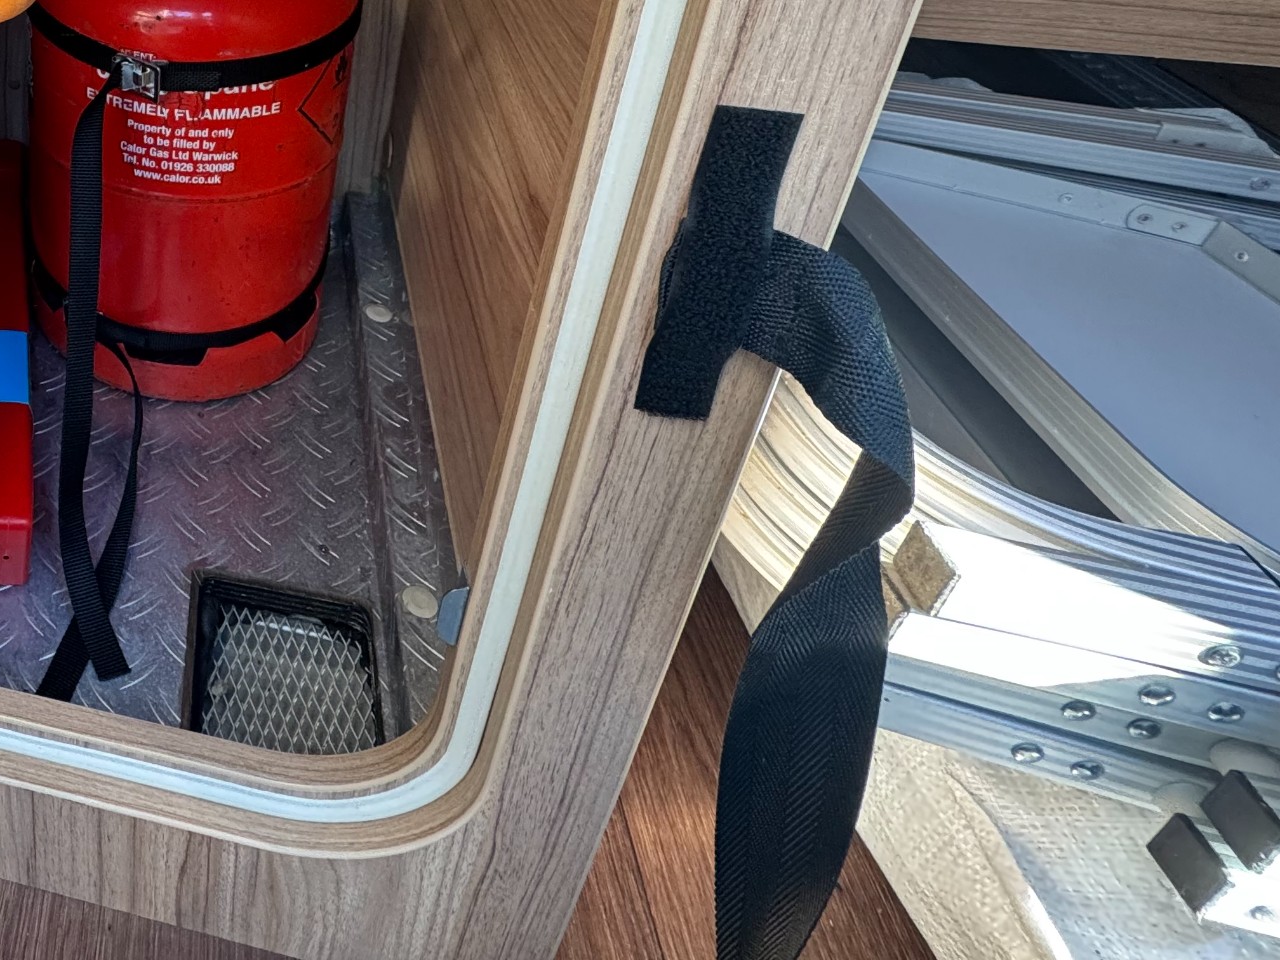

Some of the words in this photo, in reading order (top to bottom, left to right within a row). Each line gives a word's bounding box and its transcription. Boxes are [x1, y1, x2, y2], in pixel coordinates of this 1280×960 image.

[127, 118, 172, 137] Property
[174, 126, 186, 137] of
[188, 127, 209, 138] and
[211, 127, 235, 139] only
[120, 141, 147, 156] Calor
[149, 147, 169, 159] Gas
[172, 149, 190, 161] Ltd
[192, 150, 239, 162] Warwick
[143, 134, 154, 145] to
[157, 136, 170, 147] be
[173, 137, 200, 150] filled
[202, 139, 216, 152] by
[122, 152, 140, 165] Tel.
[142, 156, 159, 169] No.
[161, 159, 194, 172] 01926
[196, 162, 236, 173] 330088
[133, 168, 222, 185] www.calor.co.uk
